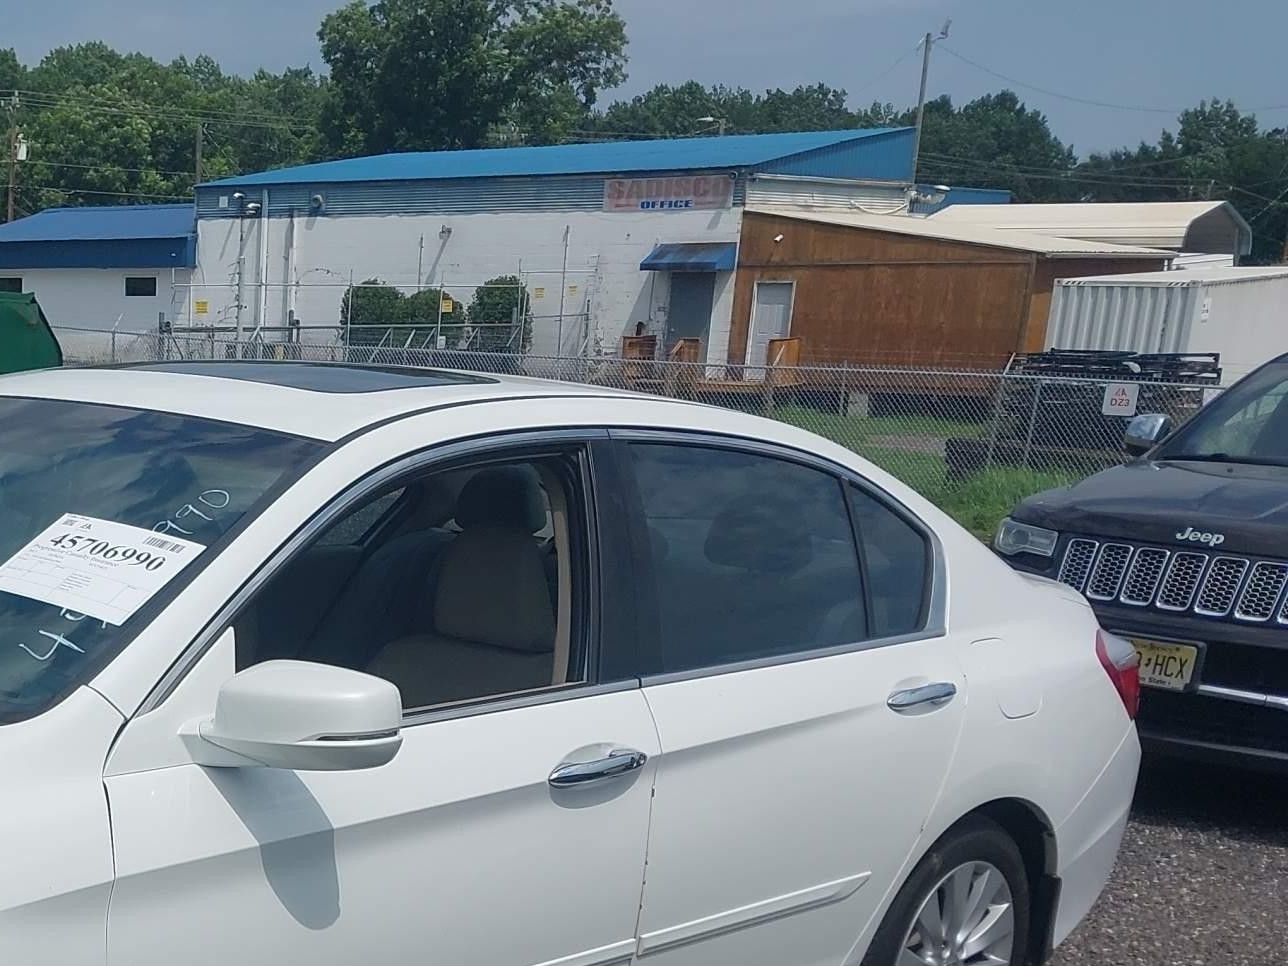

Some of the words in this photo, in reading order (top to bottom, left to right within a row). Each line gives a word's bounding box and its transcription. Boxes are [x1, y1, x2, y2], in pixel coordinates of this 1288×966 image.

[640, 199, 693, 209] OFFICE
[1110, 398, 1130, 407] DZ3
[1175, 527, 1225, 547] Jeep
[49, 533, 166, 572] 45706990
